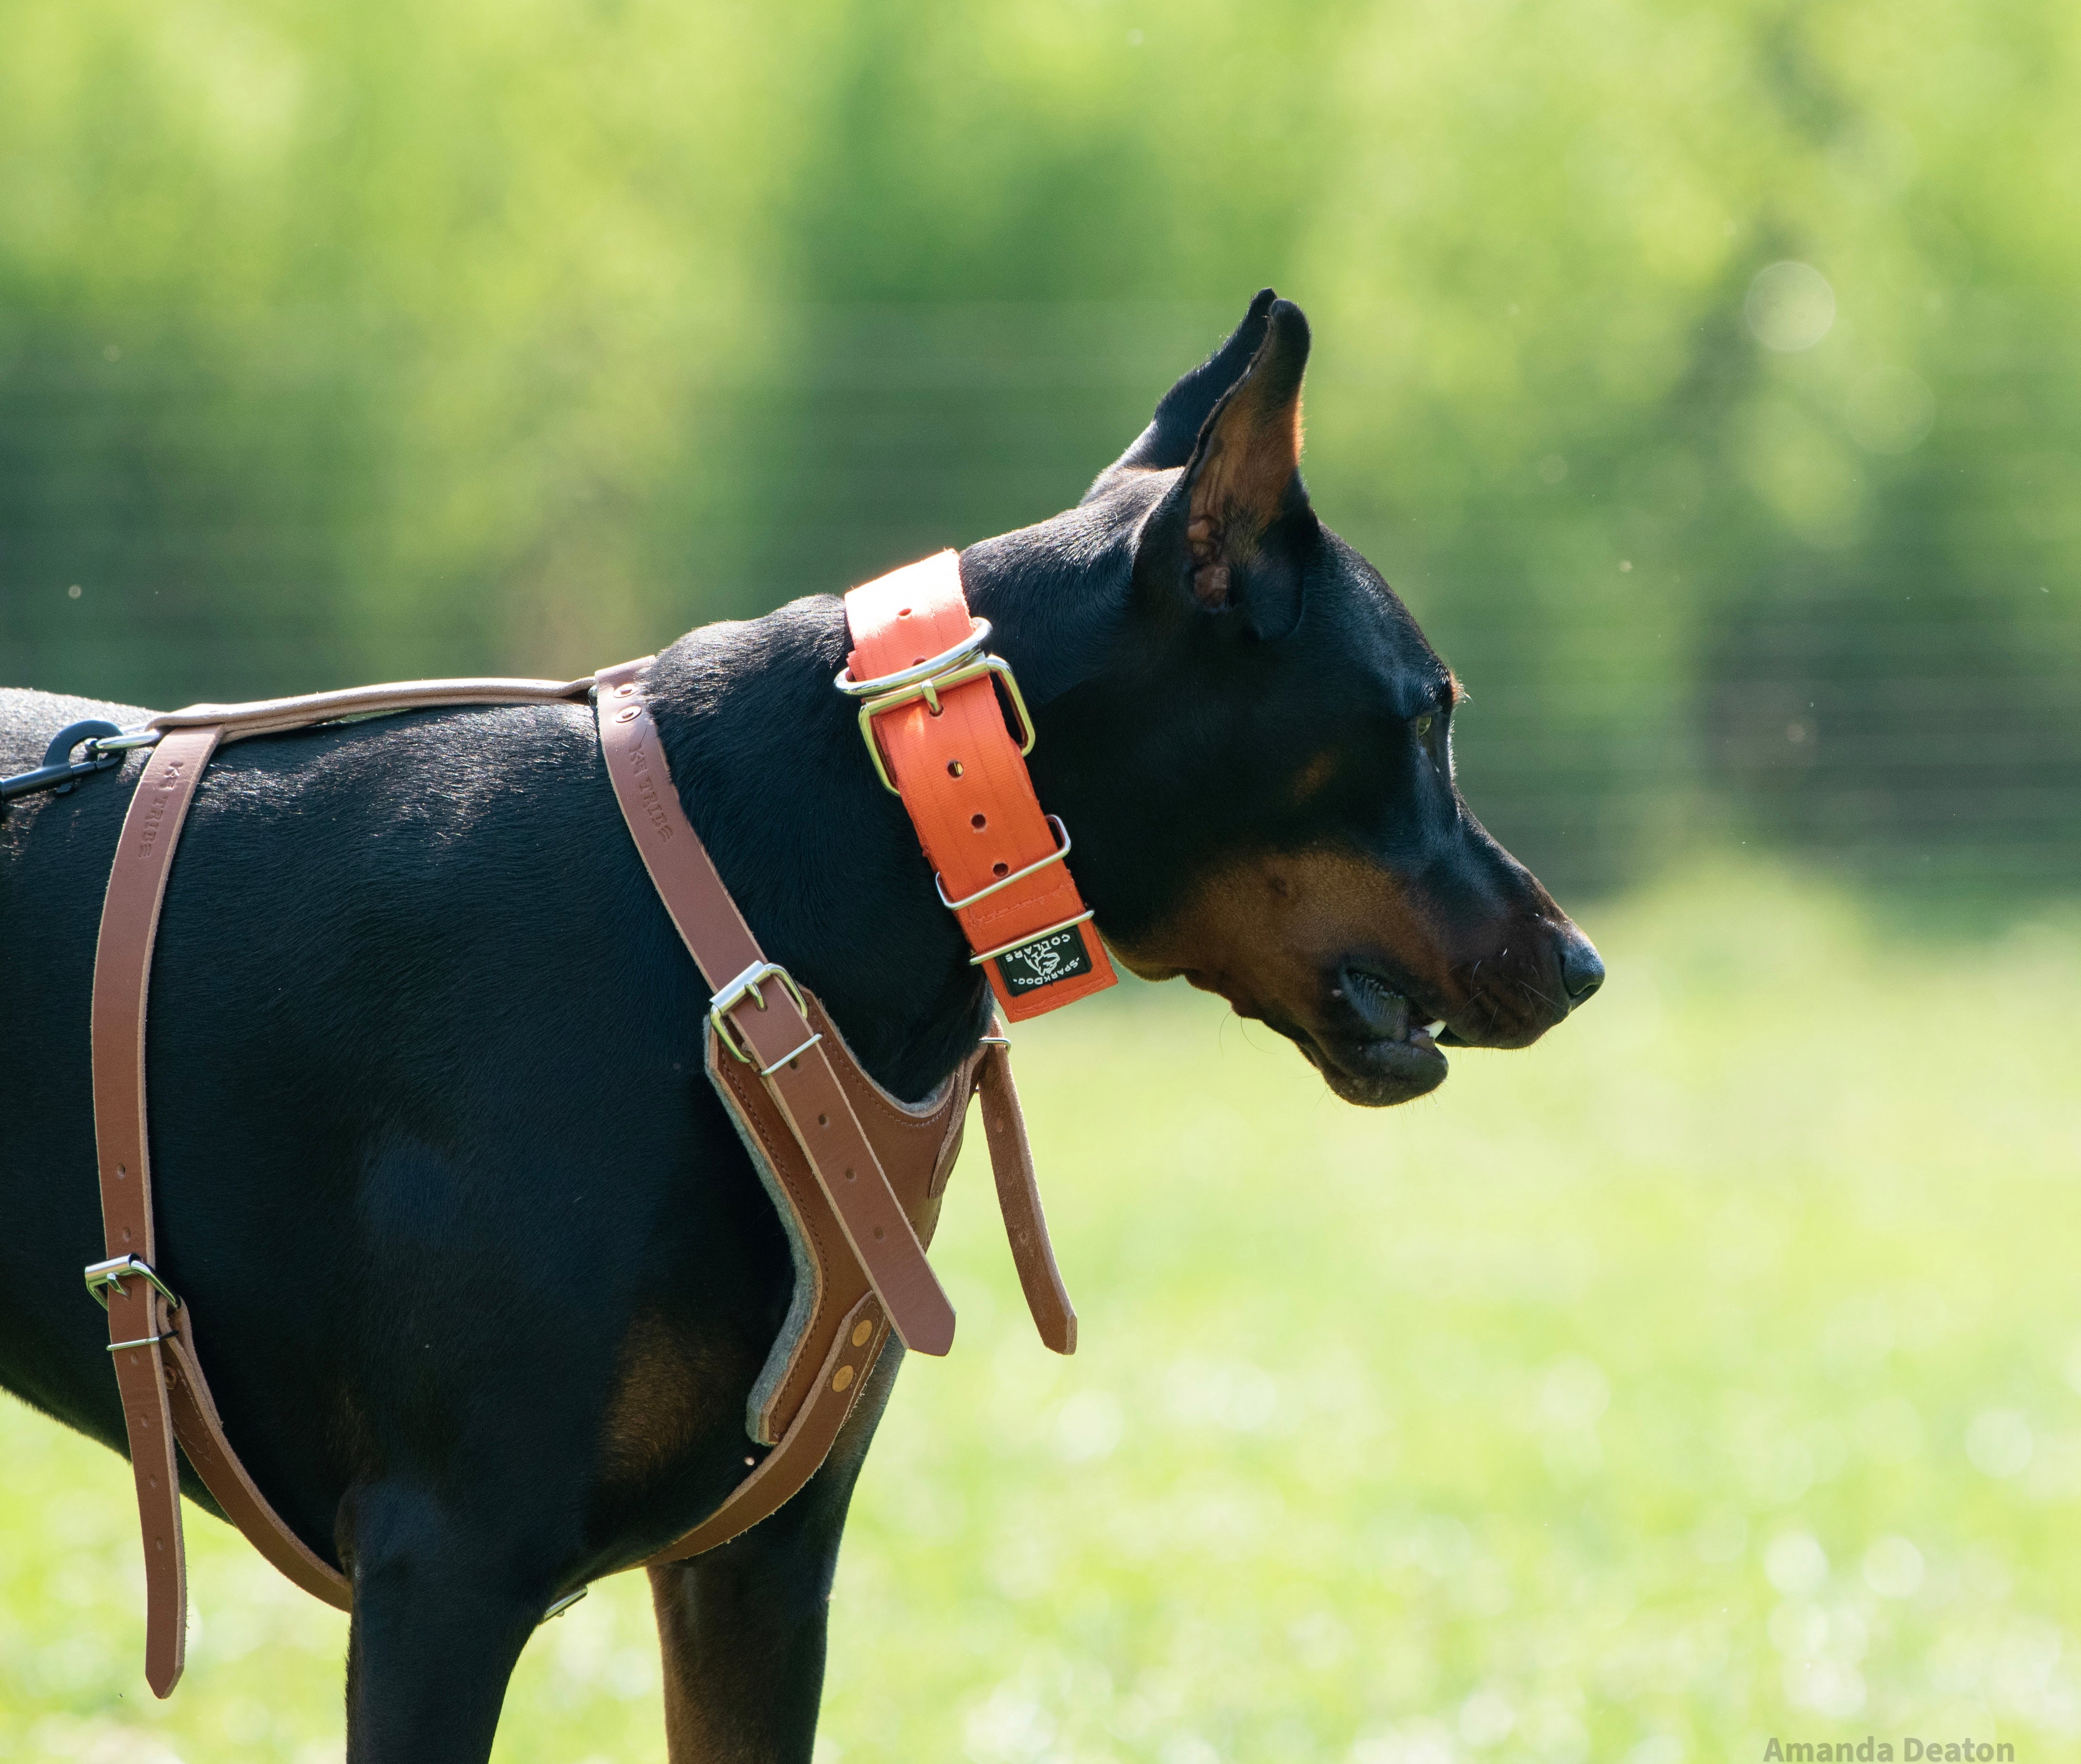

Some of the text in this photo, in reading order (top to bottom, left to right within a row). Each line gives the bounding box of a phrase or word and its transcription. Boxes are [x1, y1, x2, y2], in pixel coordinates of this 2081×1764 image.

[138, 795, 168, 858] TRIBE
[639, 775, 673, 842] TRIBE
[1005, 933, 1071, 963] COLLARS
